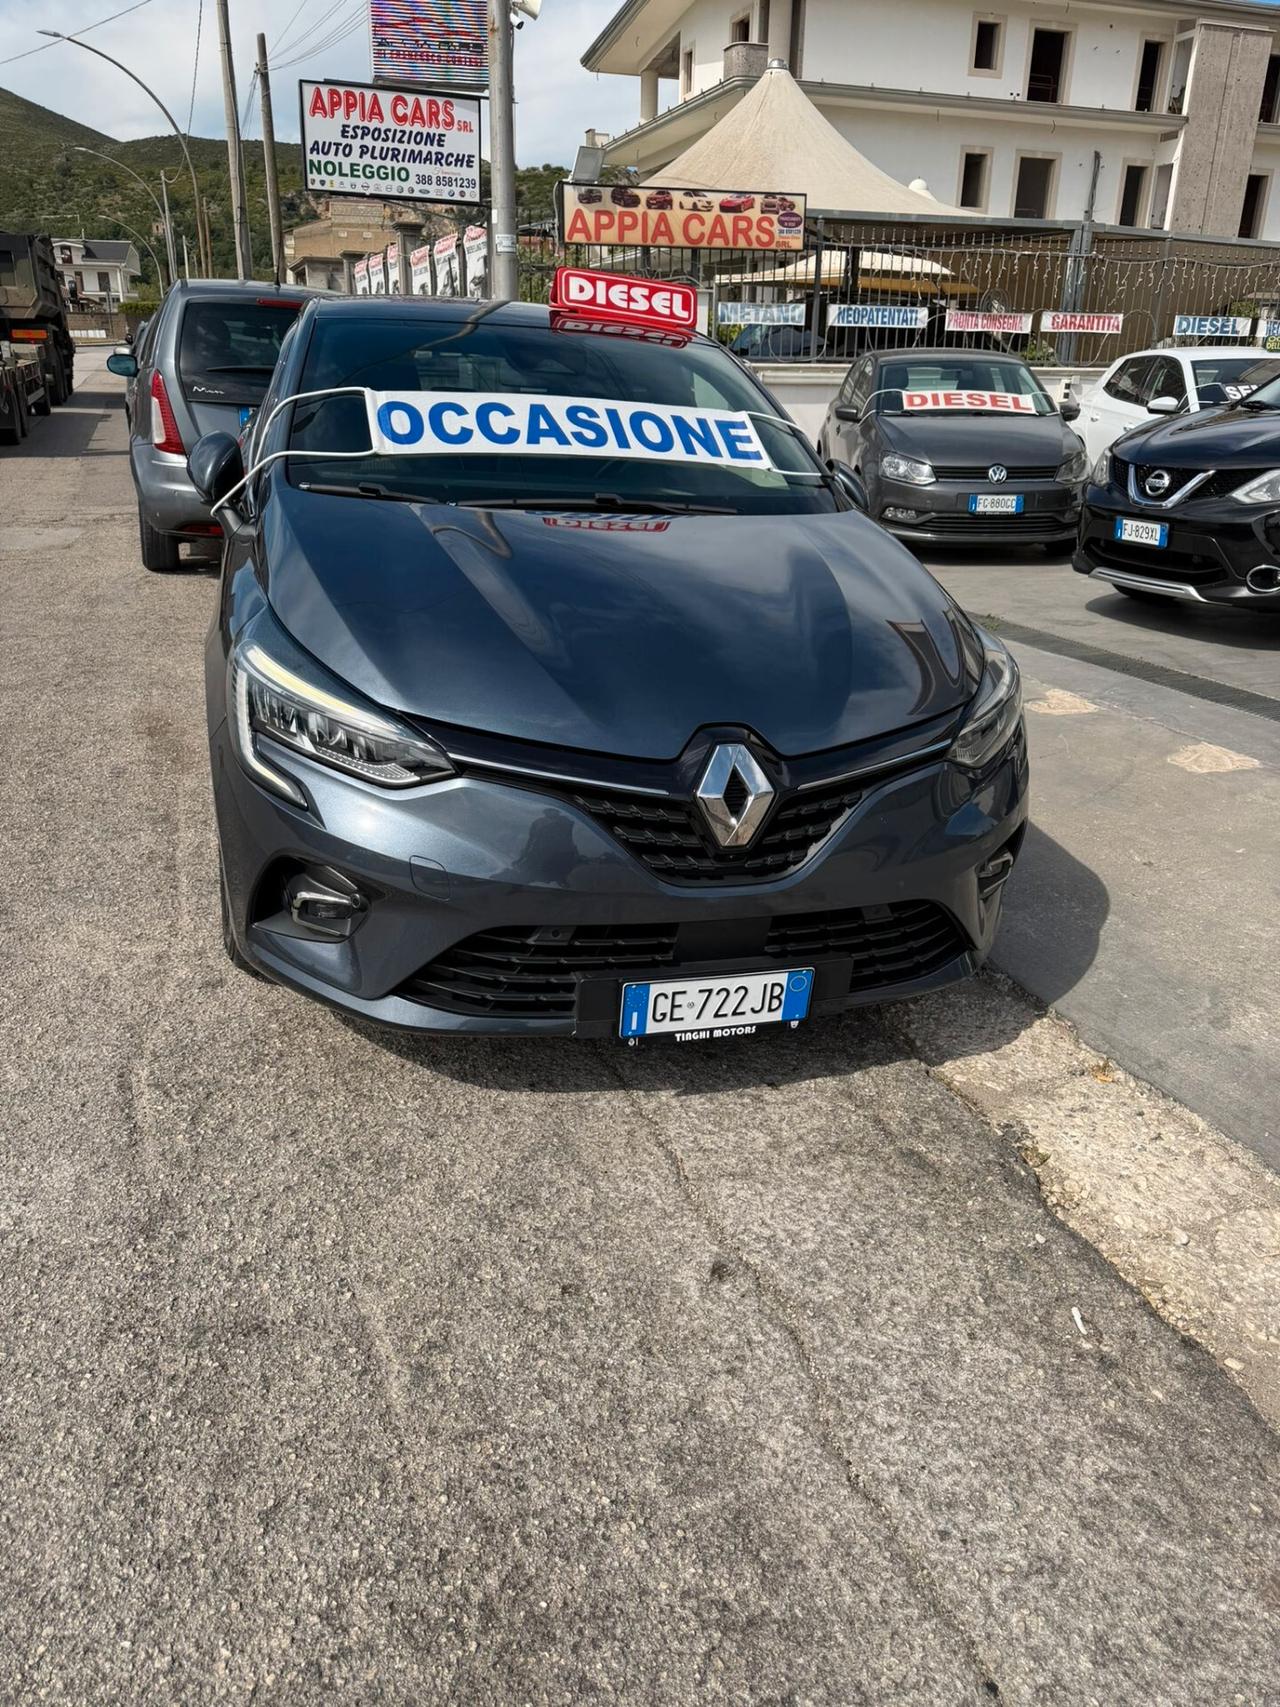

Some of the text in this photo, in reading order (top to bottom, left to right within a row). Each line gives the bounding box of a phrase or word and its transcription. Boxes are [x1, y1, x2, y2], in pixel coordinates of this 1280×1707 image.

[309, 87, 474, 133] APPIA CARS SRL
[341, 124, 446, 148] ESPOSIZIONE
[309, 140, 475, 169] AUTO PLURIMARCHE
[309, 159, 410, 182] NOLEGGIO
[415, 174, 477, 189] 388 8581239
[567, 208, 676, 245] APPIA
[682, 212, 775, 248] CARS
[568, 276, 689, 319] DIESEL
[837, 306, 919, 326] NEOPATENTATI
[947, 311, 1024, 331] PRONTA CONSEGNA
[1050, 314, 1121, 333] GARANTITA
[1176, 316, 1241, 336] DIESEL
[906, 392, 1031, 411] DIESEL
[377, 400, 764, 461] OCCASIONE
[675, 1025, 757, 1042] TINGHI MOTORS
